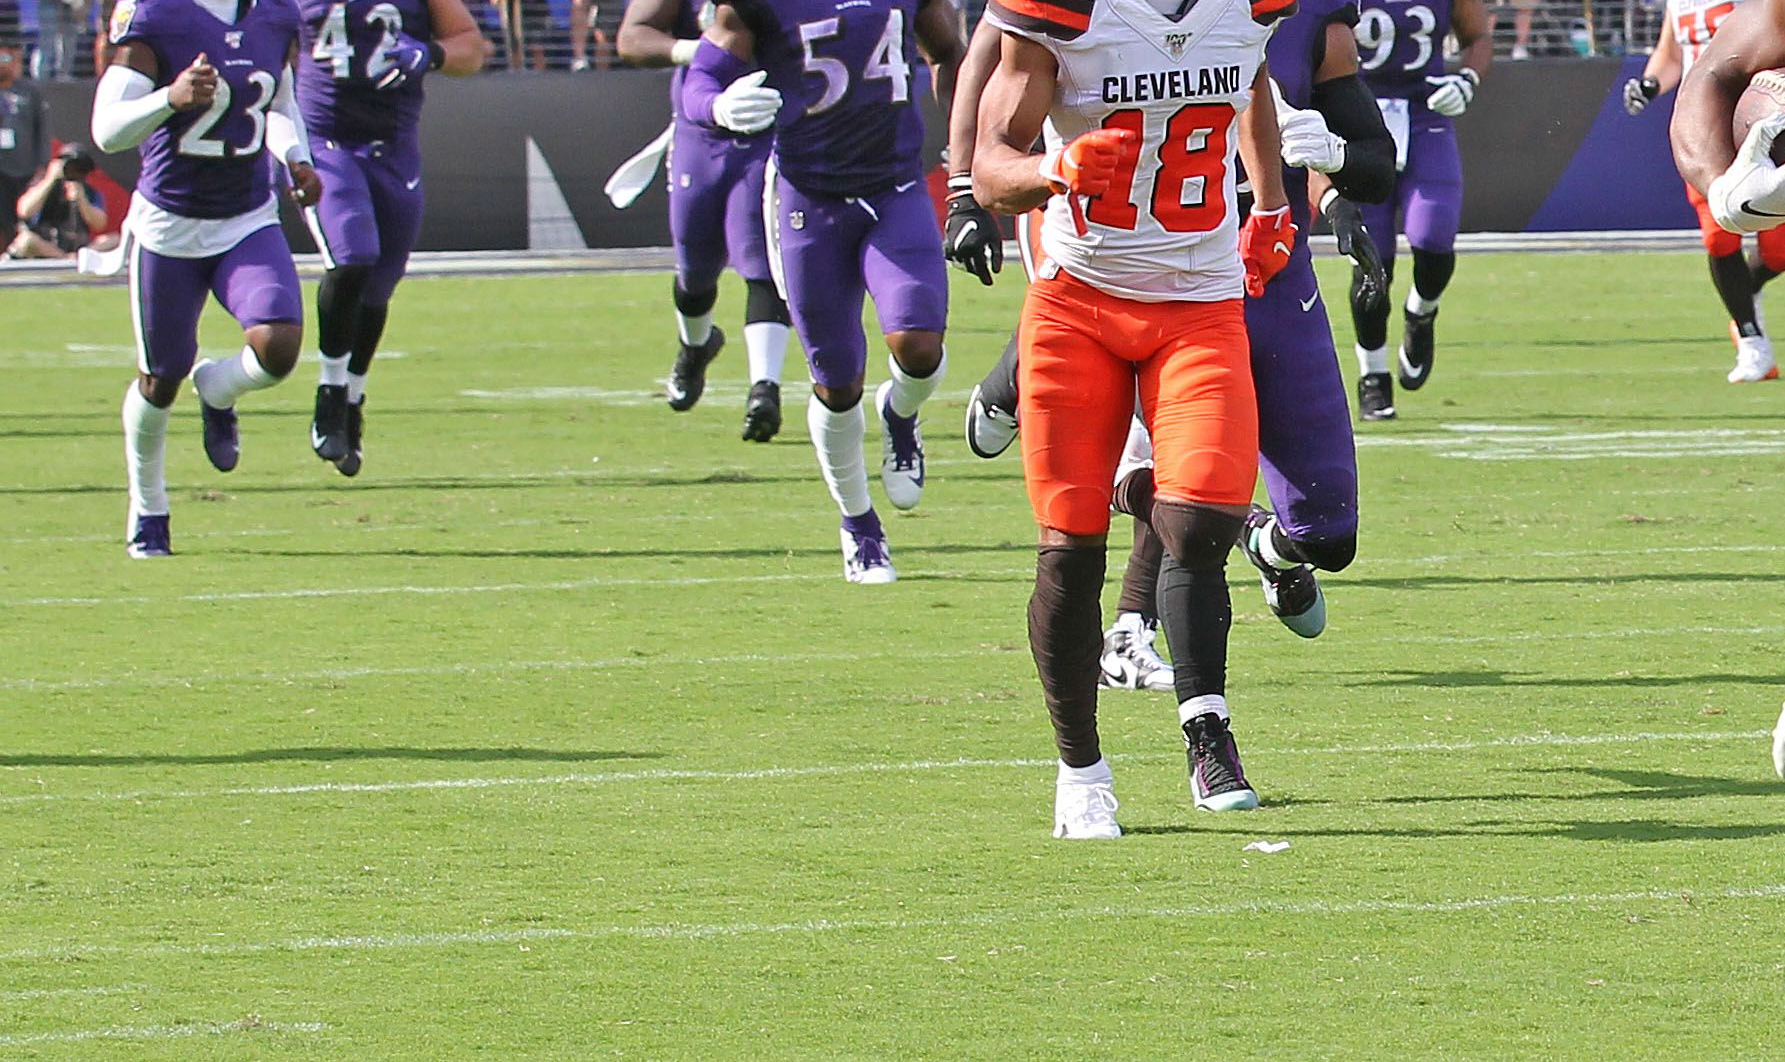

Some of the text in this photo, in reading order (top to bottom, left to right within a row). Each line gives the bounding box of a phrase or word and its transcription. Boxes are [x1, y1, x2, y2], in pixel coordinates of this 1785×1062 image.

[312, 1, 403, 89] 42
[798, 7, 912, 116] 54
[1356, 4, 1436, 72] 93
[176, 69, 279, 158] 23
[1101, 65, 1241, 105] CLEVELAND
[1085, 101, 1240, 234] 18
